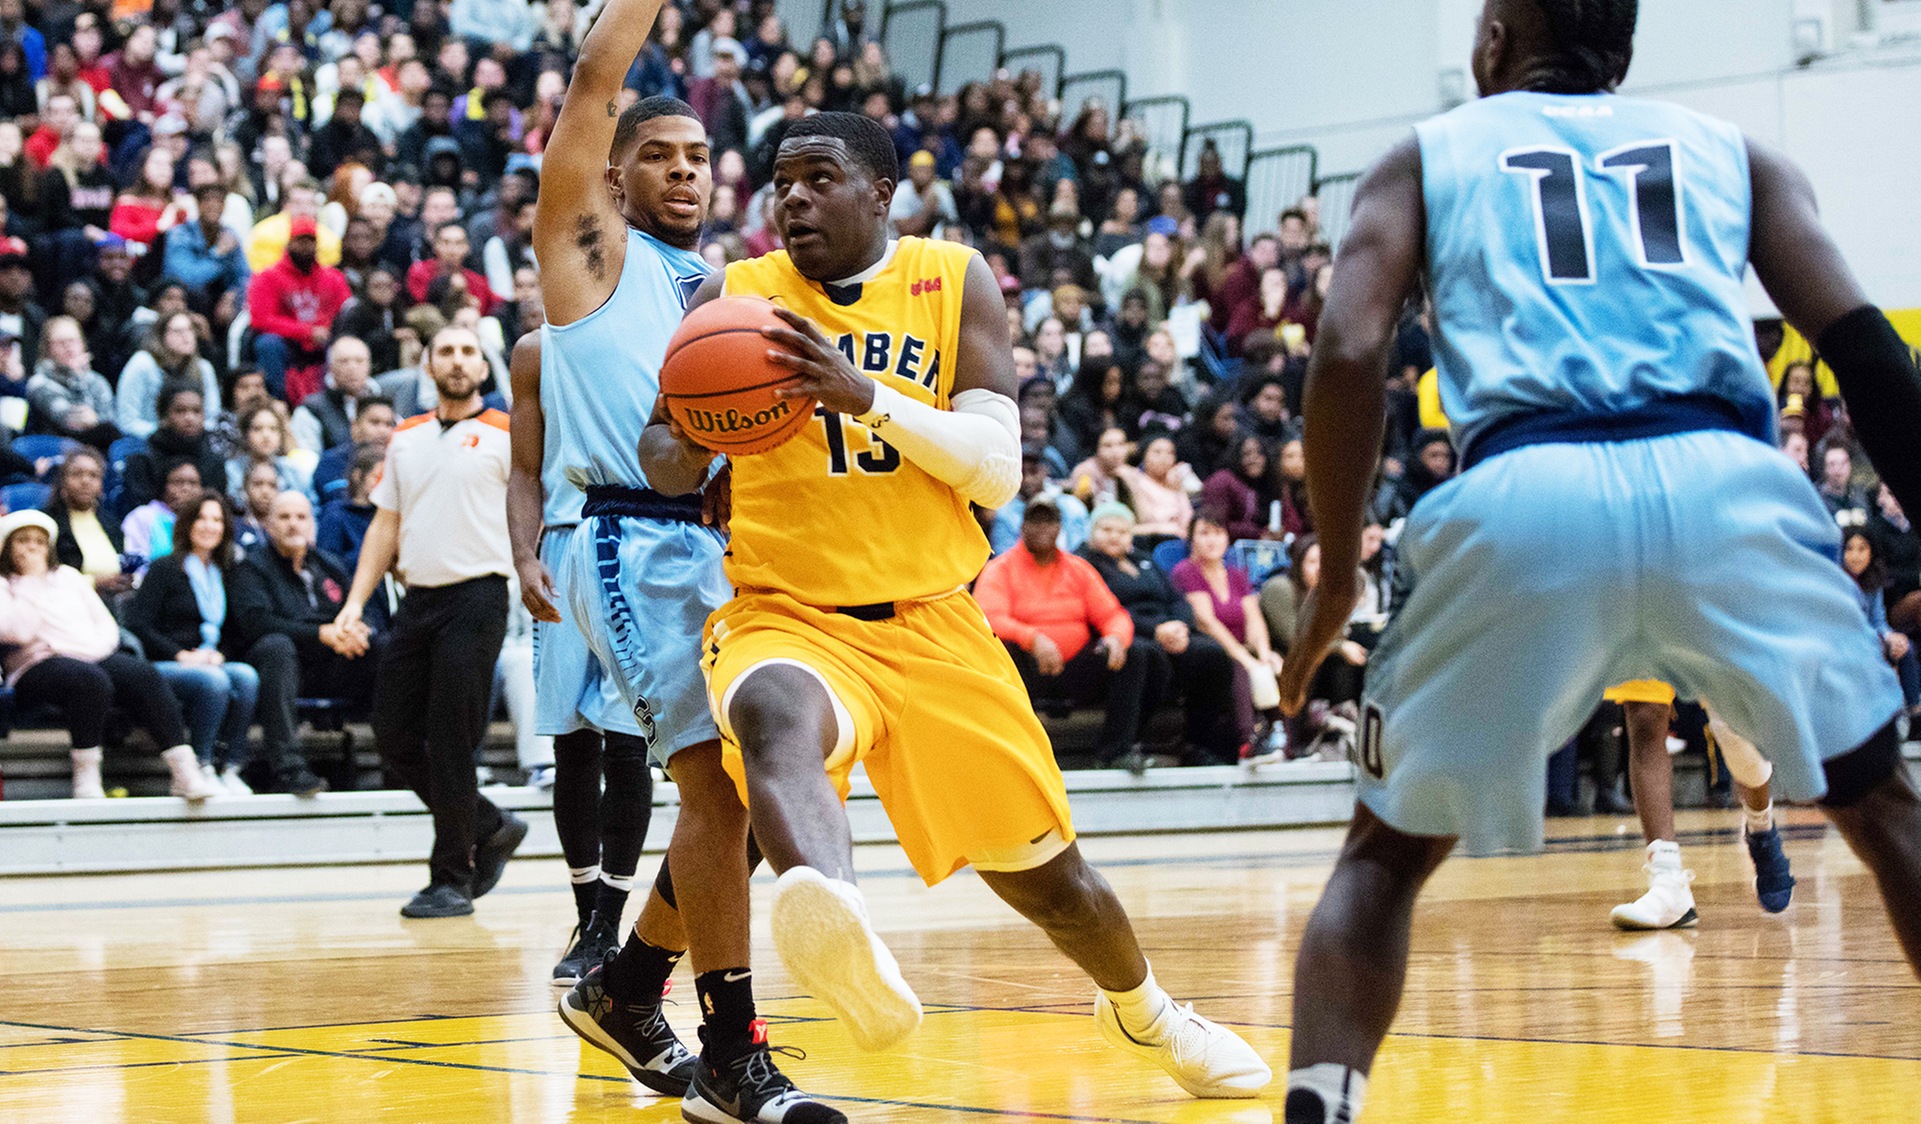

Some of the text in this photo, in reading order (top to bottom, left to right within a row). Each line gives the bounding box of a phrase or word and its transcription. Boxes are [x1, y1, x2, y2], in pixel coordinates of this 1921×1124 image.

[1498, 138, 1691, 286] 11
[684, 400, 791, 433] Wilson
[812, 402, 902, 477] 13
